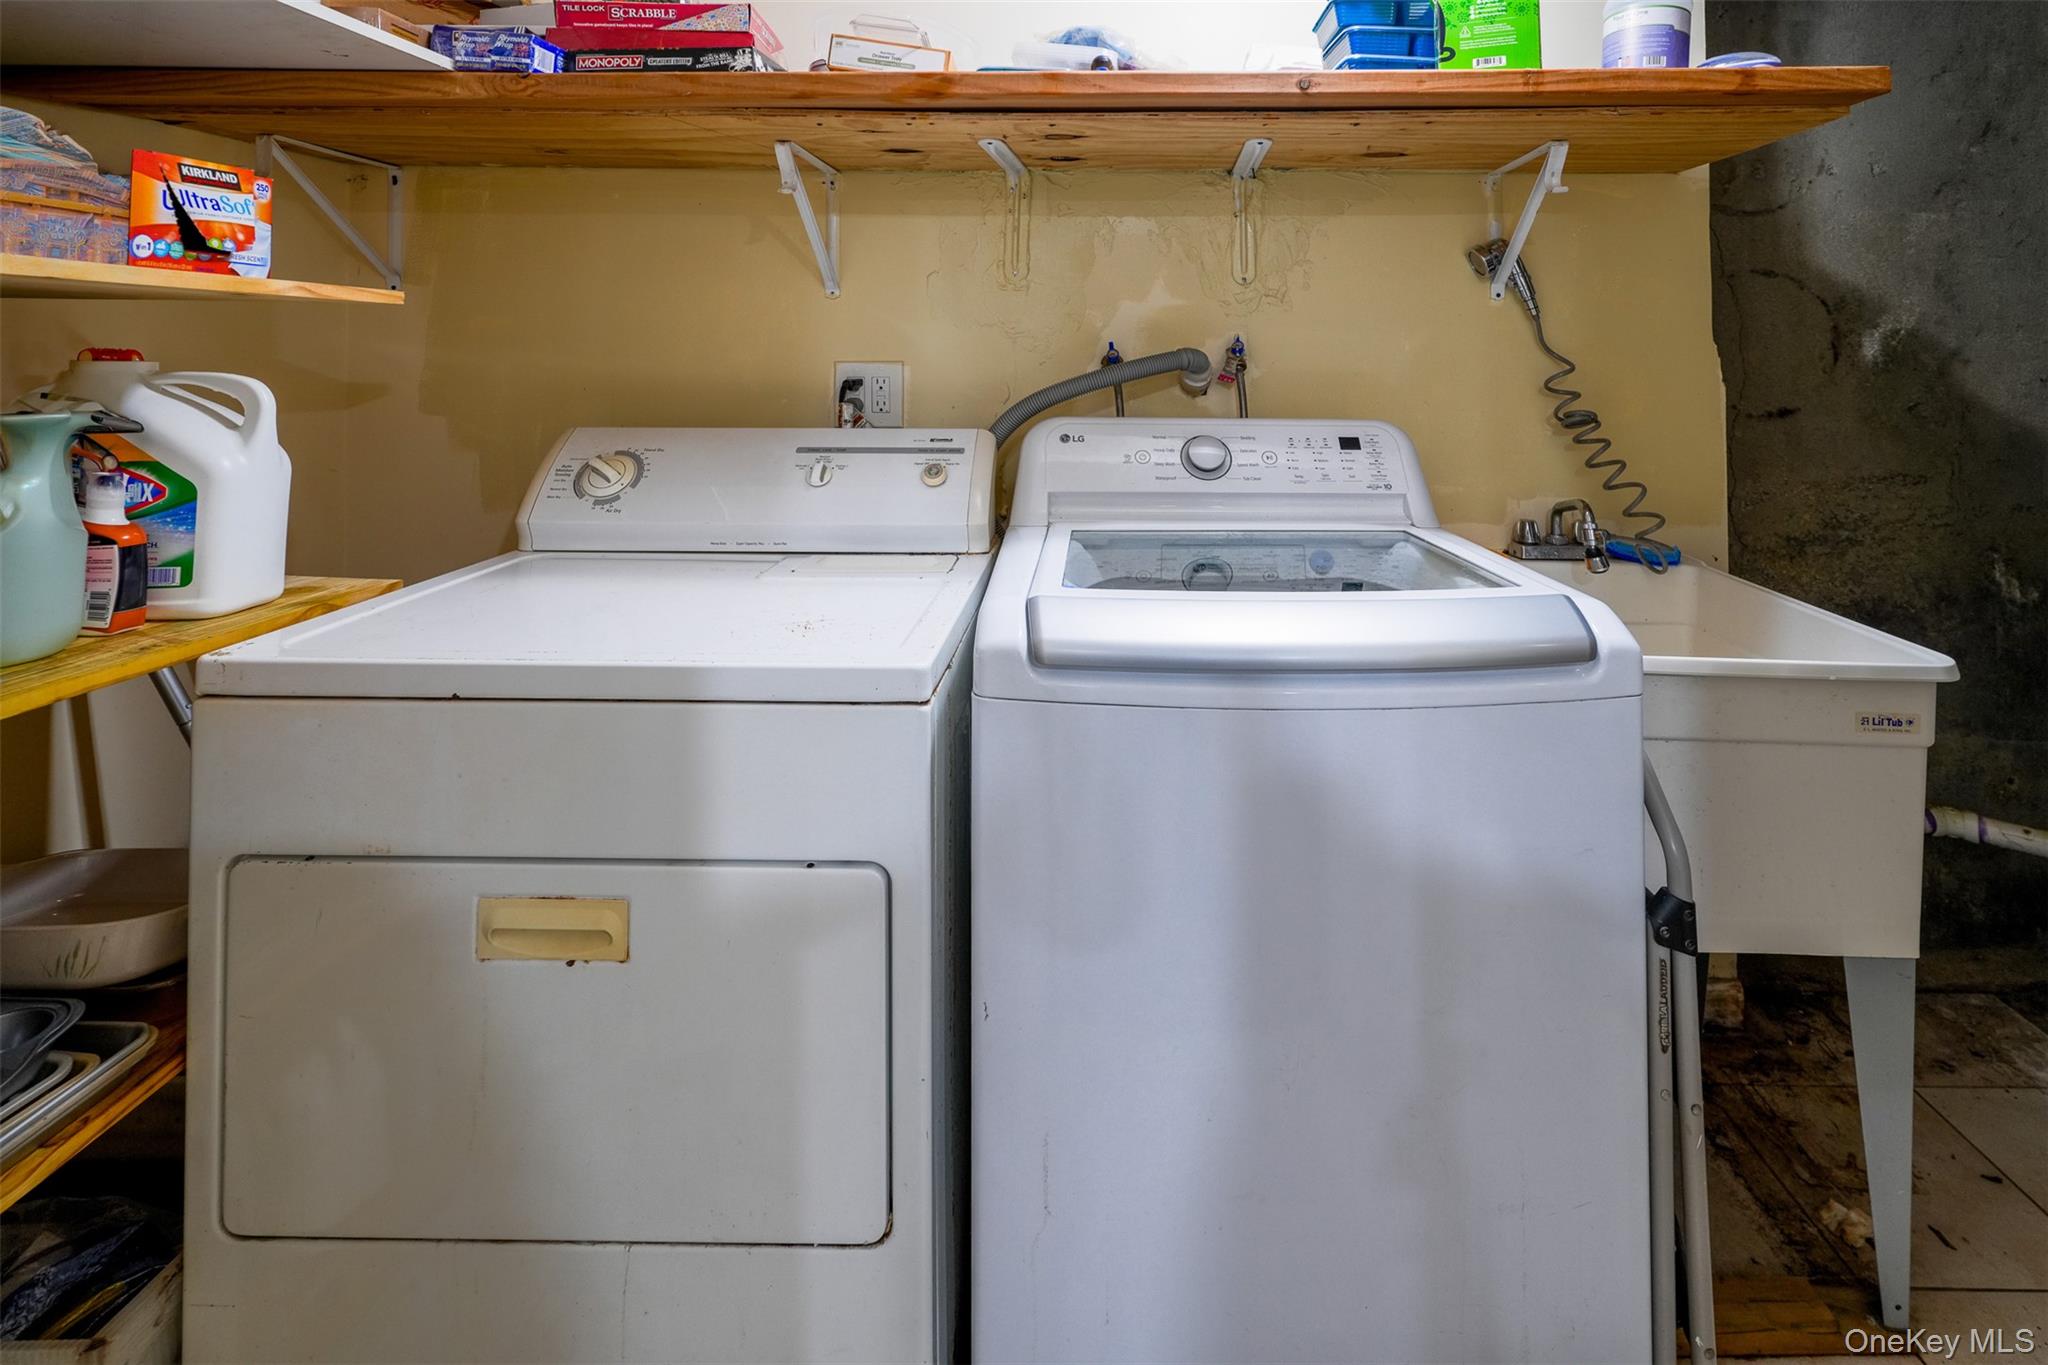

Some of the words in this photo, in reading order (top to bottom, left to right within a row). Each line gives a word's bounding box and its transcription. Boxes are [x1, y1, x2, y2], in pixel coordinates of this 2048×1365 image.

[611, 7, 677, 18] SCRABBLE
[578, 57, 641, 68] MONOPOLY
[181, 165, 238, 184] KIRKLAND
[256, 183, 269, 193] 250
[1072, 434, 1085, 443] LG
[1886, 717, 1904, 727] Tub
